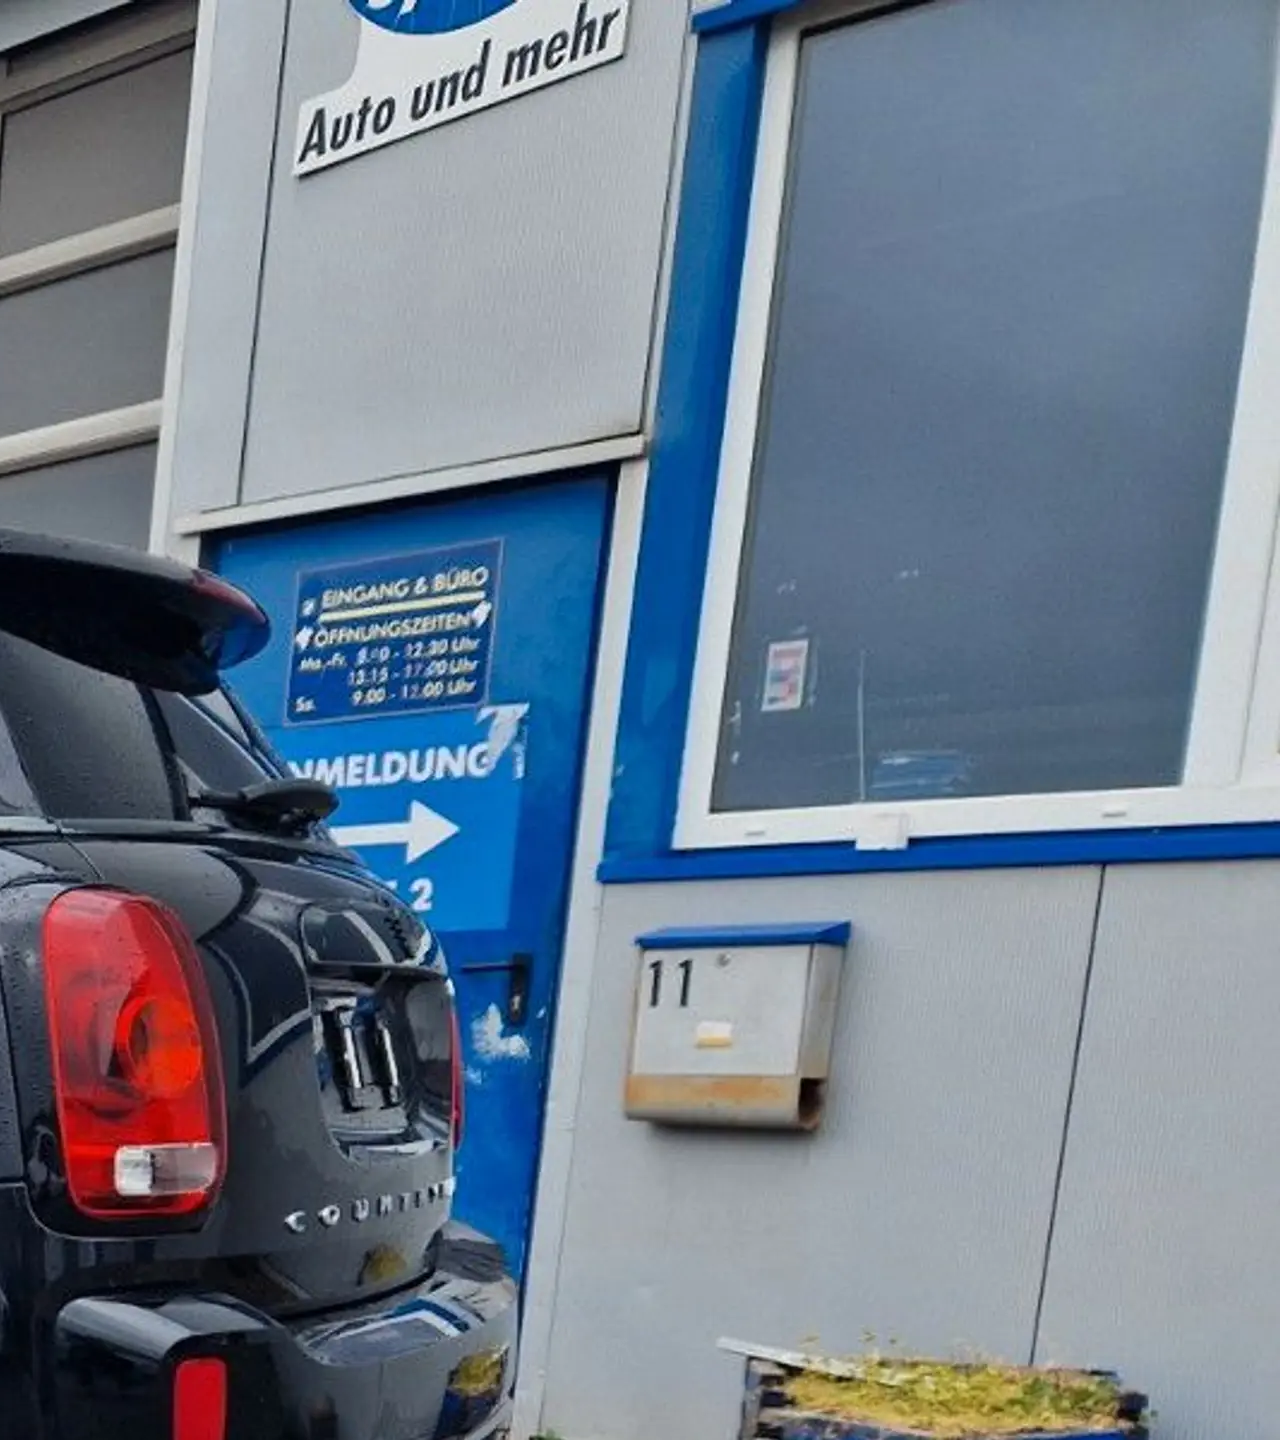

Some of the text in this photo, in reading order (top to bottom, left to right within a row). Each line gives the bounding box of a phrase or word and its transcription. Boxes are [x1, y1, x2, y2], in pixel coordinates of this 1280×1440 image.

[297, 1, 623, 163] Auto und mehr
[321, 565, 490, 609] EINGANG & BÜRO
[451, 635, 481, 653] Uhr
[450, 656, 481, 674] Uhr
[447, 677, 478, 695] Uhr
[288, 742, 493, 789] NMELDUNG
[409, 877, 434, 911] 2
[649, 959, 694, 1008] 11
